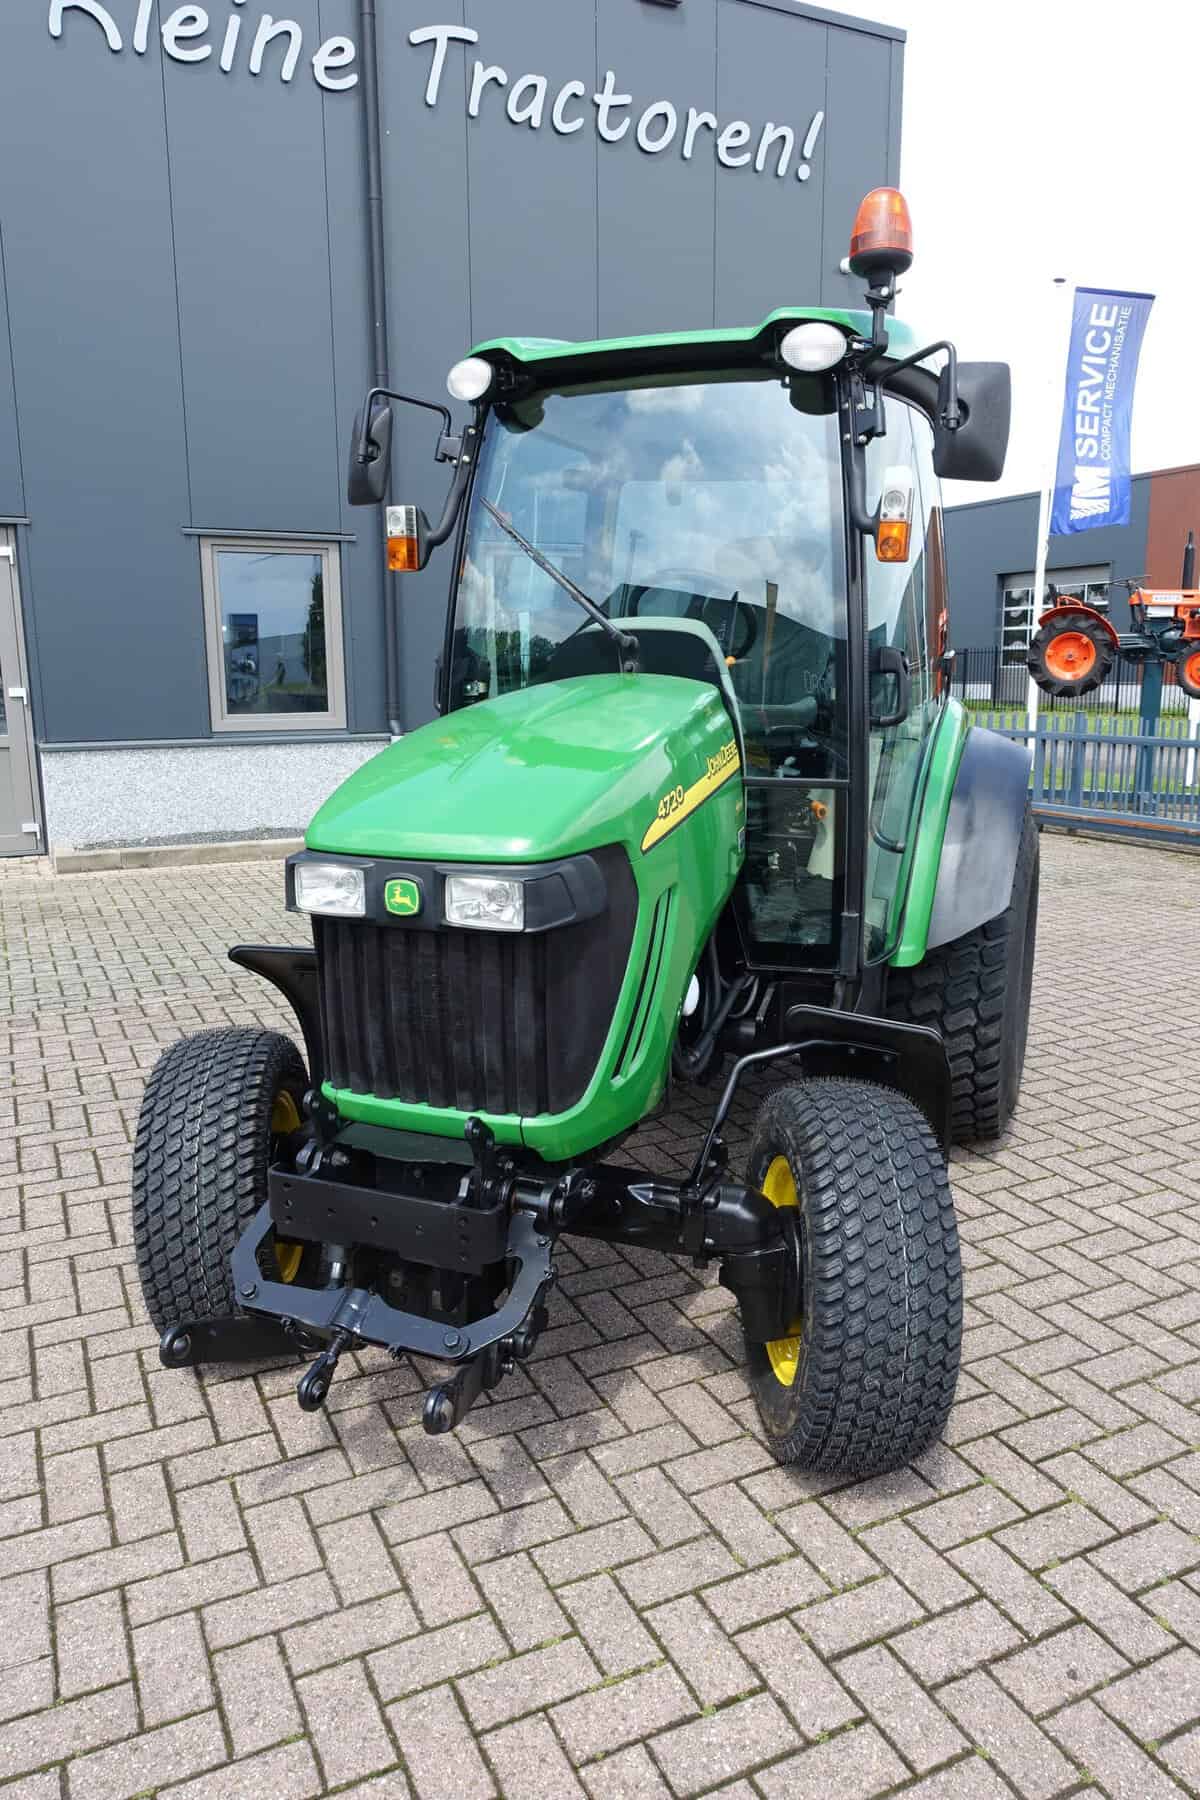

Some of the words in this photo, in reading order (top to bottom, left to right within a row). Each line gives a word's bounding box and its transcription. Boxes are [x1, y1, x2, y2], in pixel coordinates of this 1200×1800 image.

[409, 25, 824, 181] Tractoren!
[1075, 303, 1118, 458] SERVICE
[1104, 304, 1132, 400] MECHANISATIE
[1101, 402, 1113, 460] COMPACT
[658, 785, 685, 819] 4720
